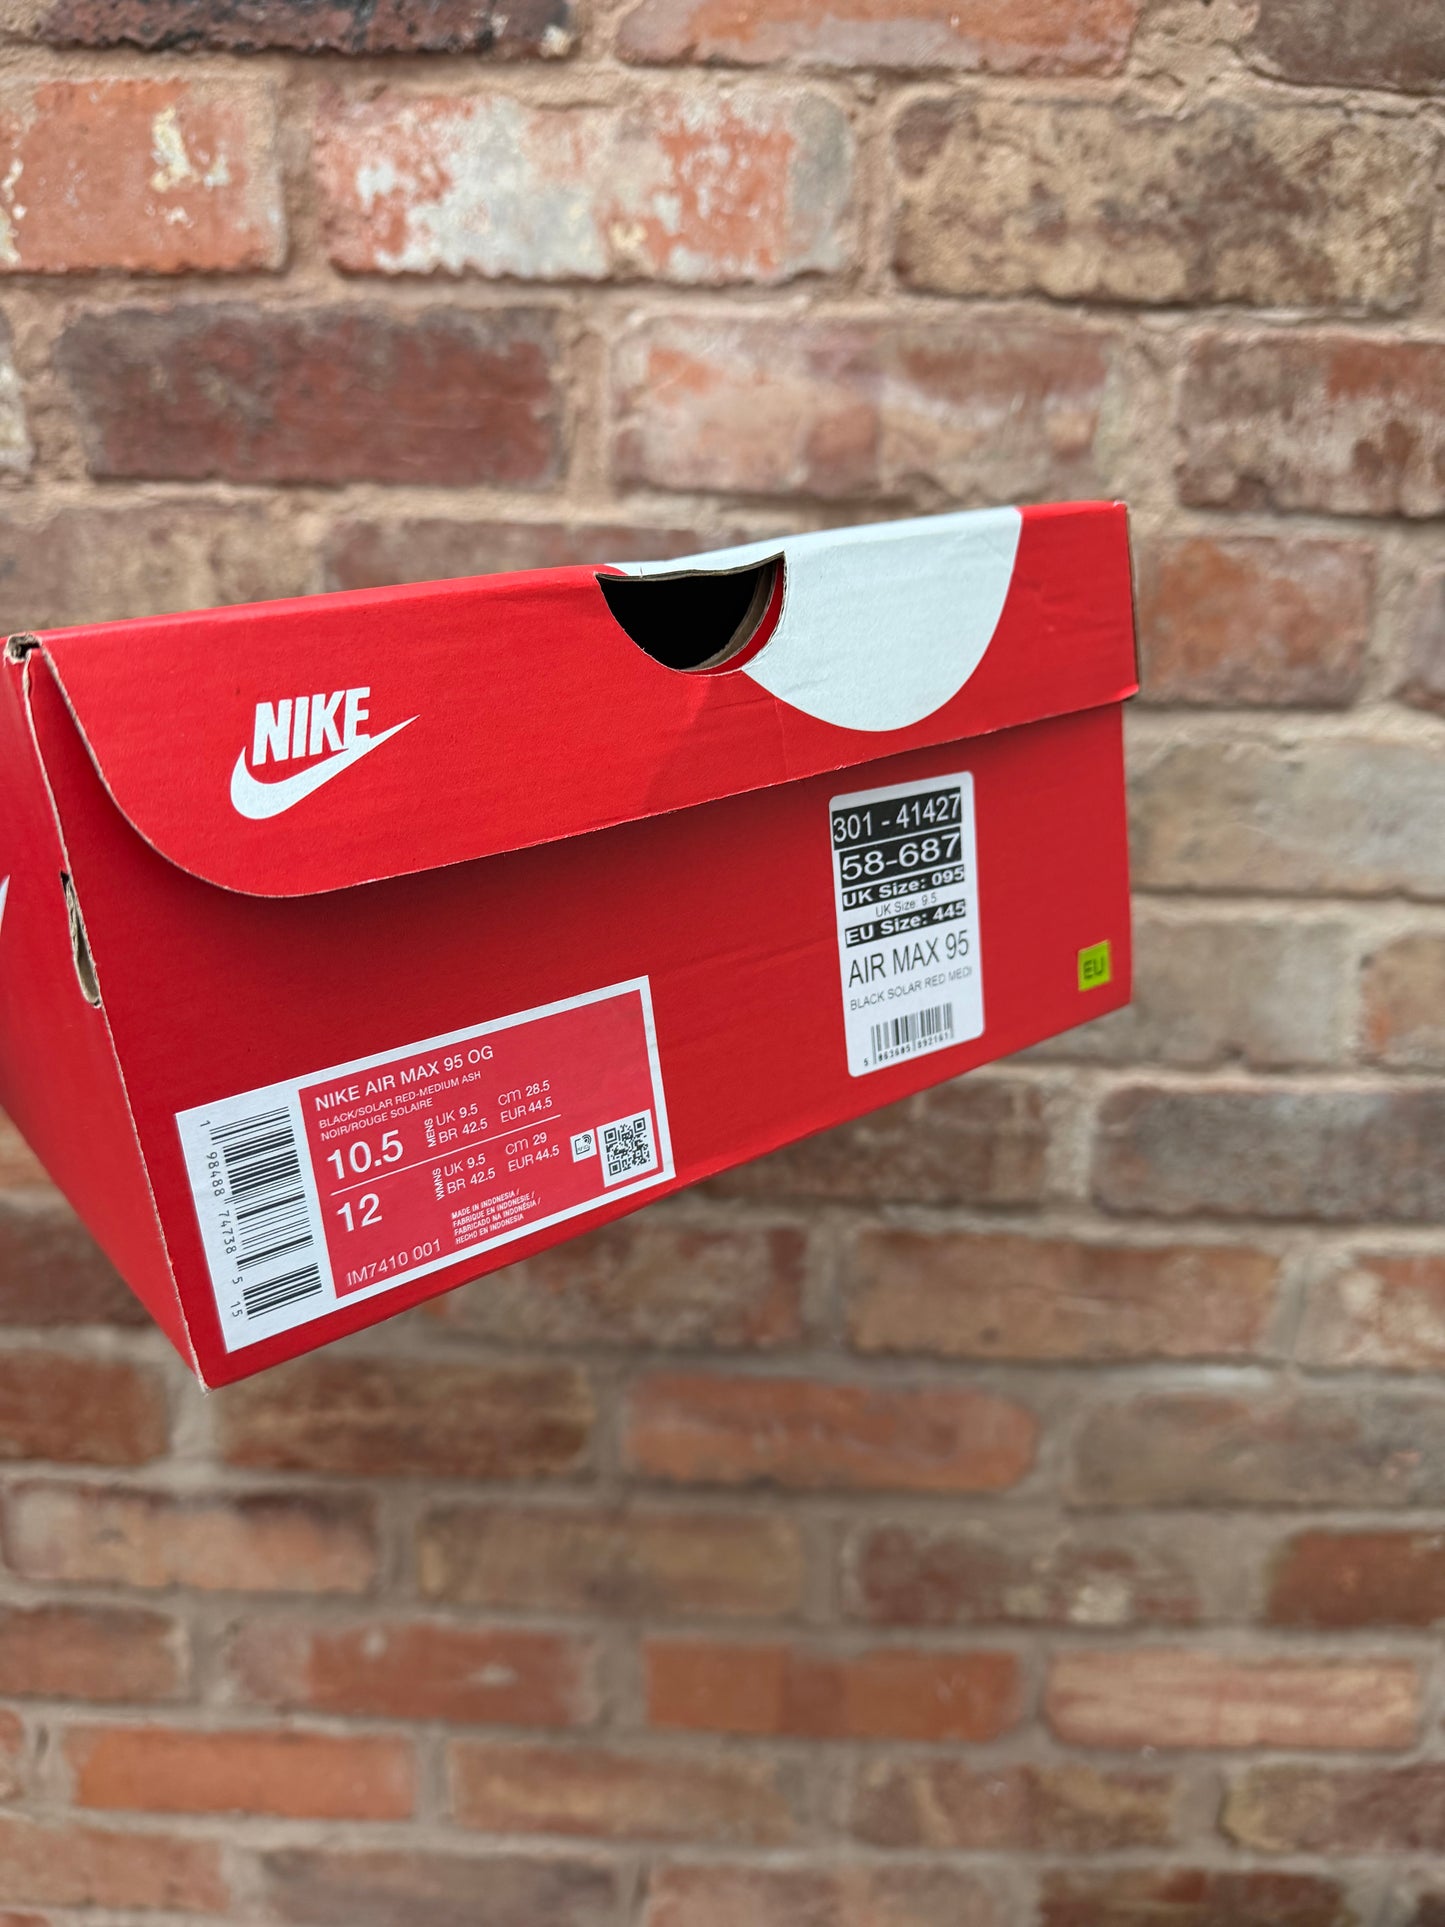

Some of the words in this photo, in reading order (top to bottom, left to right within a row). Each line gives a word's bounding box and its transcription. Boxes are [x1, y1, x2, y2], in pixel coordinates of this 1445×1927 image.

[252, 686, 371, 766] NIKE
[833, 811, 872, 842] 301
[896, 793, 961, 829] 41427
[842, 832, 960, 880] 58-687
[842, 888, 873, 908] UK
[879, 878, 927, 899] Size:
[931, 867, 964, 886] 095
[875, 903, 892, 918] UK
[921, 891, 937, 906] 9.5
[845, 923, 874, 945] EU
[880, 913, 928, 935] Size:
[932, 901, 966, 920] 445
[849, 952, 886, 988] AIR
[893, 937, 940, 975] MAX
[945, 929, 969, 960] 95
[1083, 957, 1104, 980] EU
[850, 991, 885, 1011] BLACK
[887, 980, 922, 1000] SOLAR
[924, 974, 946, 988] RED
[315, 1085, 360, 1111] NIKE
[365, 1075, 396, 1096] AIR
[400, 1060, 440, 1085] MAX
[443, 1054, 464, 1072] 95
[467, 1045, 494, 1064] OG
[526, 1080, 550, 1097] 28.5
[319, 1099, 393, 1129] BLACK/SOLAR
[395, 1077, 459, 1107] RED-MEDIUM
[461, 1071, 482, 1085] ASH
[436, 1110, 456, 1126] UK
[459, 1103, 478, 1119] 9.5
[500, 1105, 527, 1123] EUR
[528, 1096, 553, 1113] 44.5
[200, 1120, 211, 1128] 1
[321, 1111, 388, 1141] NOIR/ROUGE
[391, 1098, 433, 1118] SOLAIRE
[424, 1118, 437, 1148] MENS
[438, 1128, 458, 1143] BR
[462, 1117, 488, 1135] 42.5
[533, 1131, 548, 1147] 29
[326, 1129, 404, 1180] 10.5
[444, 1161, 464, 1177] UK
[467, 1153, 486, 1169] 9.5
[508, 1154, 534, 1172] EUR
[536, 1144, 560, 1161] 44.5
[206, 1152, 225, 1197] 98488
[432, 1167, 445, 1201] WMNS
[447, 1178, 466, 1194] BR
[470, 1167, 496, 1185] 42.5
[336, 1193, 383, 1232] 12
[451, 1206, 471, 1220] MADE
[472, 1204, 480, 1212] IN
[481, 1190, 516, 1209] INDONESIA
[486, 1206, 495, 1216] EN
[218, 1210, 237, 1255] 74738
[454, 1218, 490, 1236] FABRICADO
[492, 1213, 501, 1222] NA
[455, 1231, 478, 1245] HECHO
[480, 1227, 489, 1236] EN
[490, 1214, 524, 1232] INDONESIA
[345, 1251, 408, 1286] IM7410
[413, 1238, 441, 1261] 001
[232, 1276, 243, 1285] 5
[230, 1301, 243, 1318] 15
